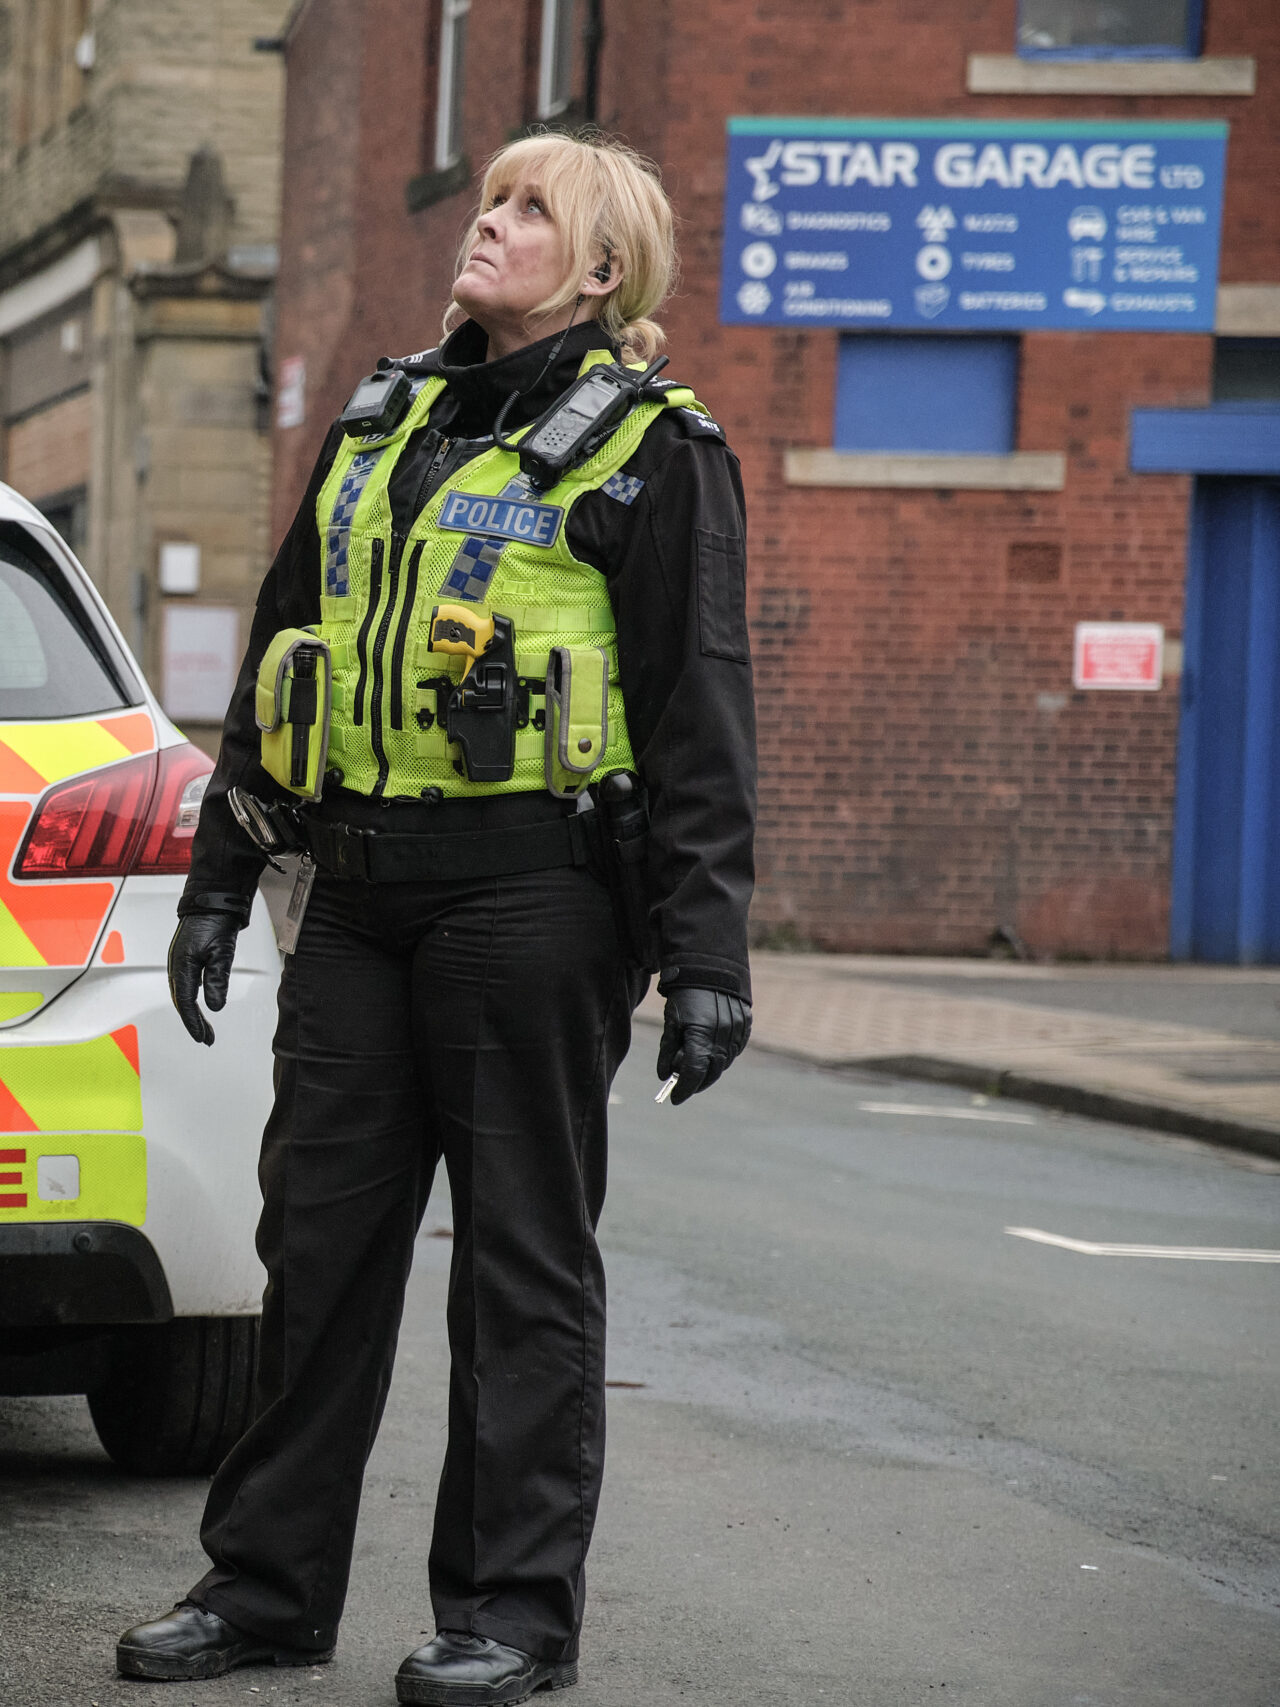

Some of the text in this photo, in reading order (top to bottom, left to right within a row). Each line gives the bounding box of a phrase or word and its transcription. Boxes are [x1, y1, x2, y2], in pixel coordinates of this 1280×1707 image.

[781, 141, 1204, 189] STAR GARAGE LTD
[446, 497, 553, 540] POLICE
